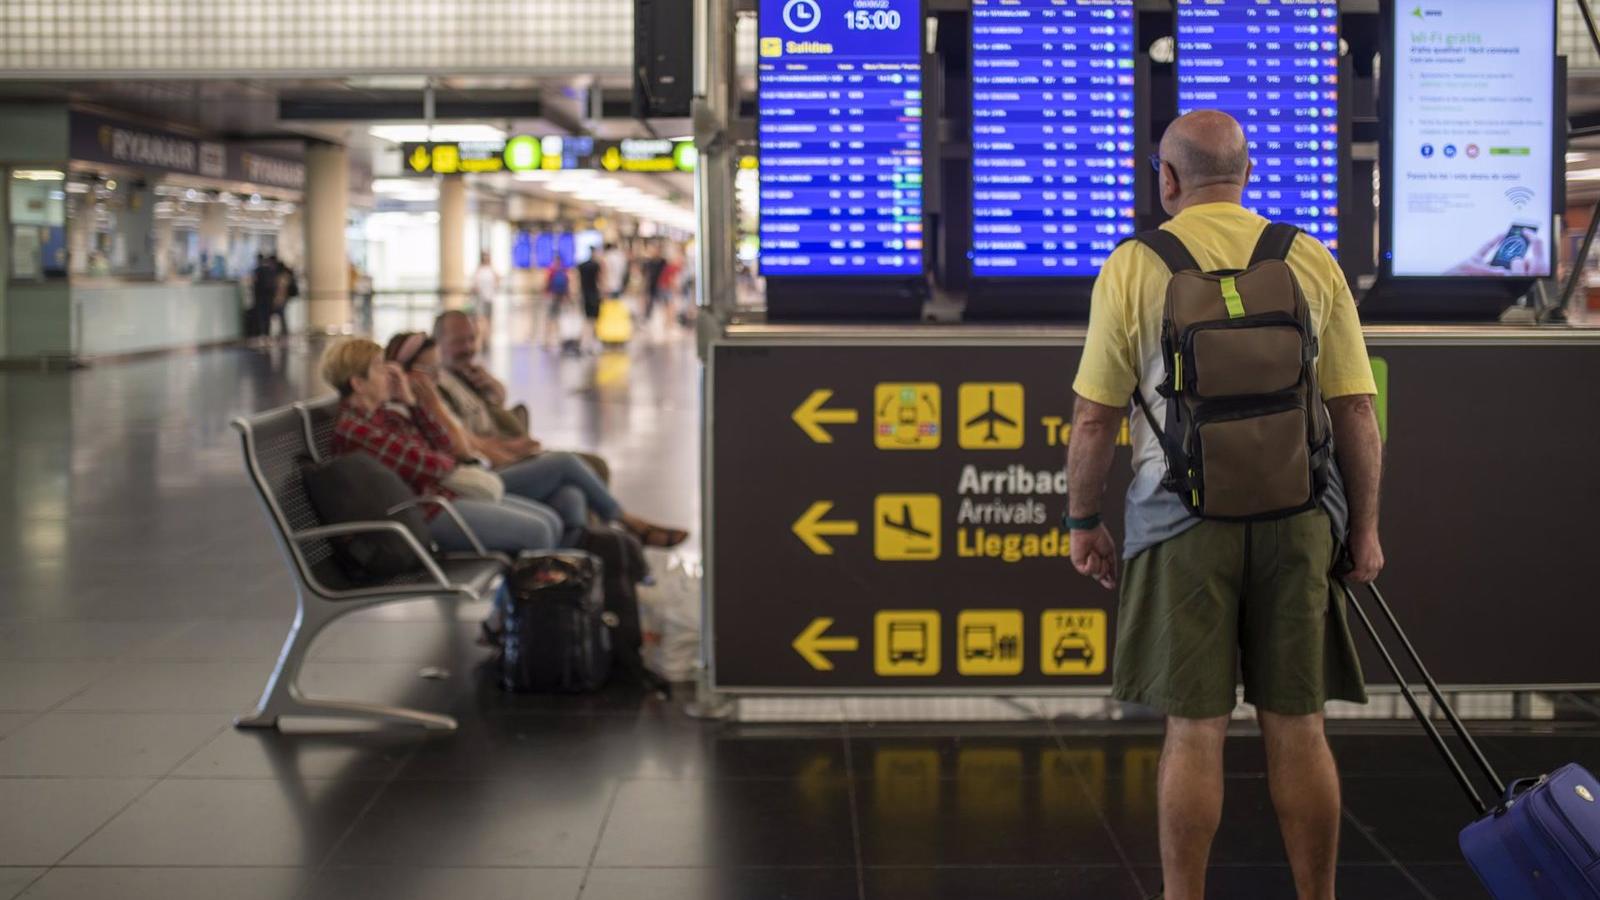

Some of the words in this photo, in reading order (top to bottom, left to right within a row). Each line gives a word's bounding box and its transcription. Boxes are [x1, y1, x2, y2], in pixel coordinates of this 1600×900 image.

[844, 10, 900, 30] 15:00
[958, 465, 1068, 494] Arribad
[957, 499, 1047, 524] Arrivals
[957, 528, 1070, 562] Llegada
[1055, 616, 1093, 628] TAXI
